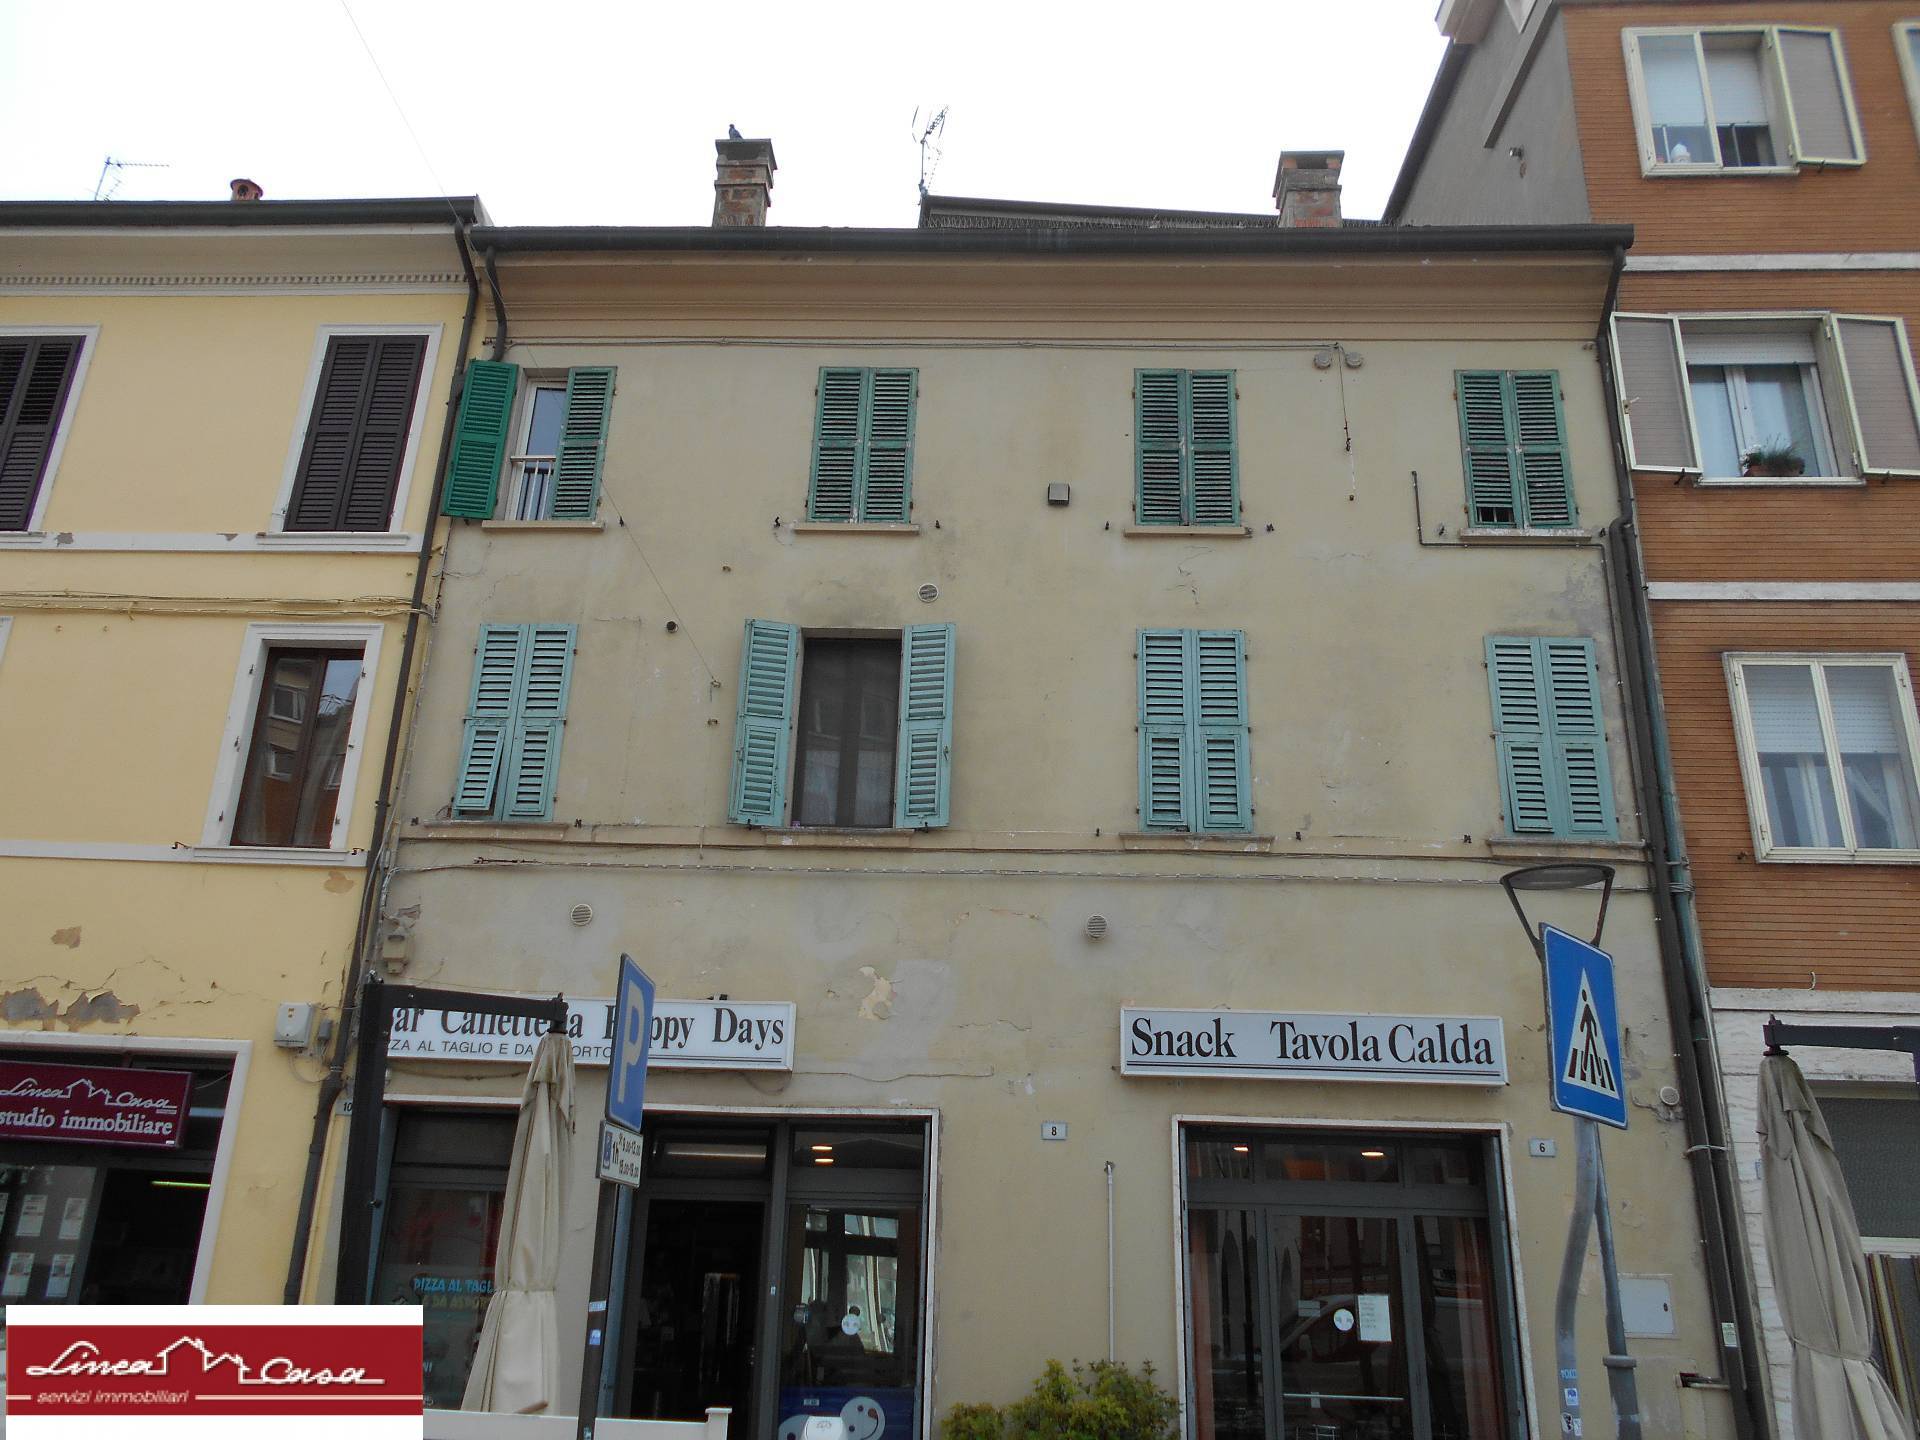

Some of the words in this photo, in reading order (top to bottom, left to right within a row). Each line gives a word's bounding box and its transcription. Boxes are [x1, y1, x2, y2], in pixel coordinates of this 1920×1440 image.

[391, 1006, 425, 1033] ar
[602, 1004, 695, 1049] Hppy
[712, 1007, 784, 1050] Days
[416, 1040, 436, 1052] AL
[441, 1041, 493, 1054] TAGLIO
[499, 1044, 508, 1055] E
[514, 1044, 534, 1056] DA
[617, 979, 645, 1104] P
[1131, 1017, 1238, 1058] Snack
[1269, 1020, 1383, 1062] Tavola
[1388, 1022, 1495, 1065] Calda
[115, 1091, 171, 1108] Casa
[343, 1102, 353, 1112] 10
[0, 1106, 56, 1128] studio
[60, 1109, 173, 1135] immobiliare
[1051, 1126, 1057, 1136] 8
[1539, 1142, 1546, 1153] 6
[414, 1278, 446, 1293] PIZZA
[448, 1279, 463, 1293] AL
[465, 1279, 494, 1294] TAGL
